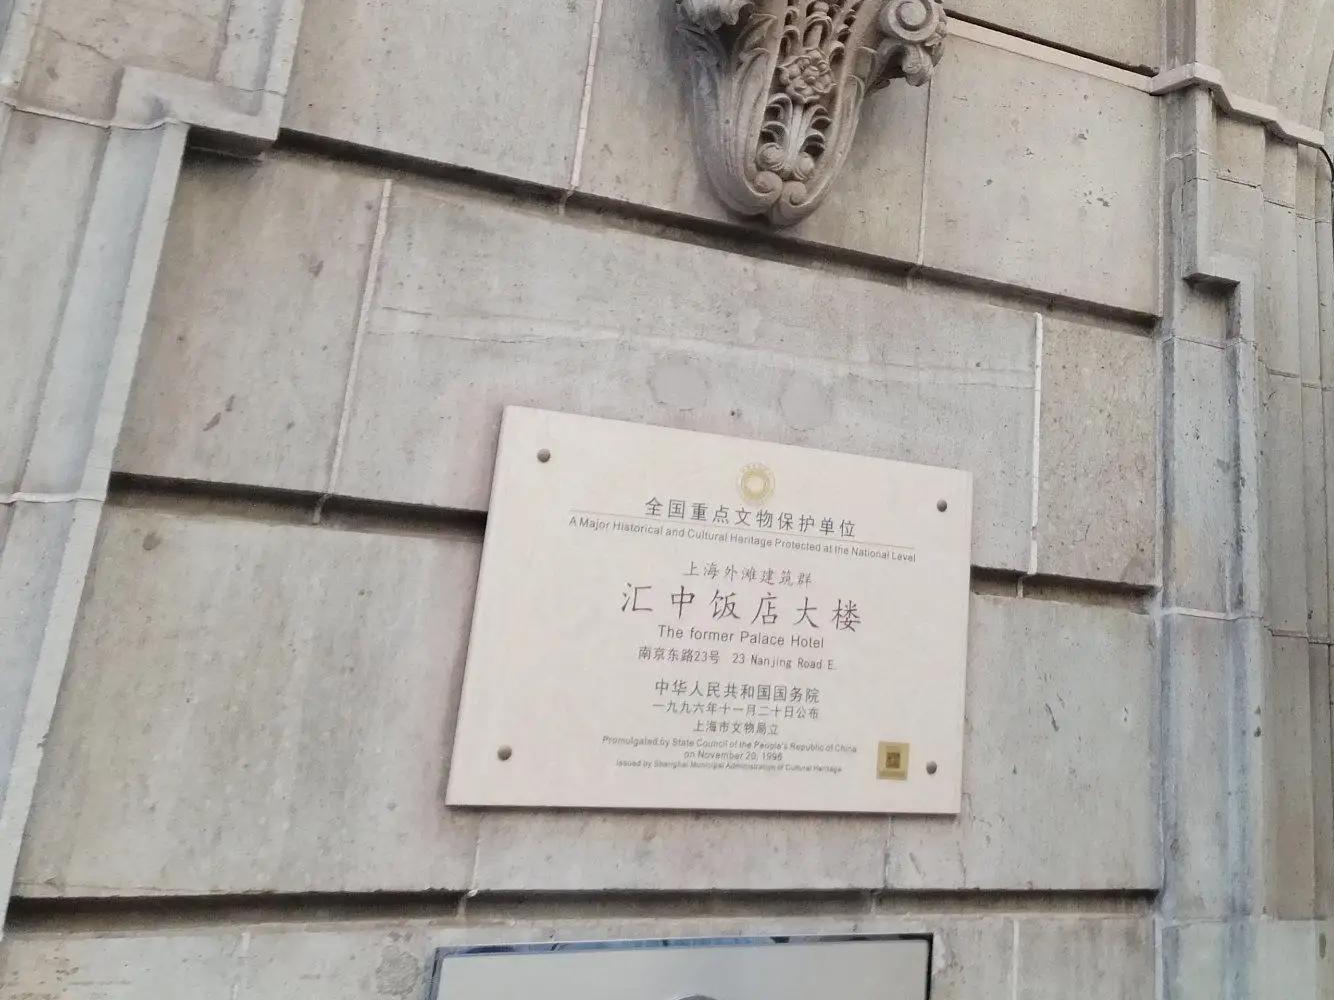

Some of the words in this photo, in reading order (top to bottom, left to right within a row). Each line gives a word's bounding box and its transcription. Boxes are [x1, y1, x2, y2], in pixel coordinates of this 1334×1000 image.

[645, 496, 856, 538] 全国重点文物保护单位
[568, 515, 577, 527] A
[579, 517, 610, 531] Major
[612, 519, 663, 536] Historical
[665, 526, 685, 538] and
[687, 528, 728, 543] Cultural
[730, 533, 773, 548] Heritage
[774, 538, 821, 553] Protected
[823, 543, 833, 553] at
[834, 543, 849, 555] the
[851, 544, 890, 560] National
[891, 548, 916, 563] Level
[682, 561, 815, 587] 上海外滩建筑群
[621, 582, 862, 633] 汇中饭店大楼
[657, 624, 684, 639] The
[690, 626, 735, 644] former
[740, 631, 785, 647] Palace
[791, 634, 825, 649] Hotel
[637, 645, 720, 665] 南京东路23号
[732, 653, 745, 665] 23
[750, 655, 792, 669] Nanjing
[797, 657, 823, 670] Road
[655, 678, 820, 704] 中华人民共和国国务院
[652, 699, 819, 720] 一九九六年十一月二十日公布
[692, 719, 779, 736] 上海市文物局立
[672, 737, 695, 747] State
[696, 738, 728, 749] Council
[729, 739, 738, 749] of
[739, 740, 752, 750] the
[790, 741, 826, 753] Republic
[837, 742, 857, 754] China
[684, 750, 695, 760] on
[697, 750, 744, 761] November
[762, 751, 783, 762] 1996
